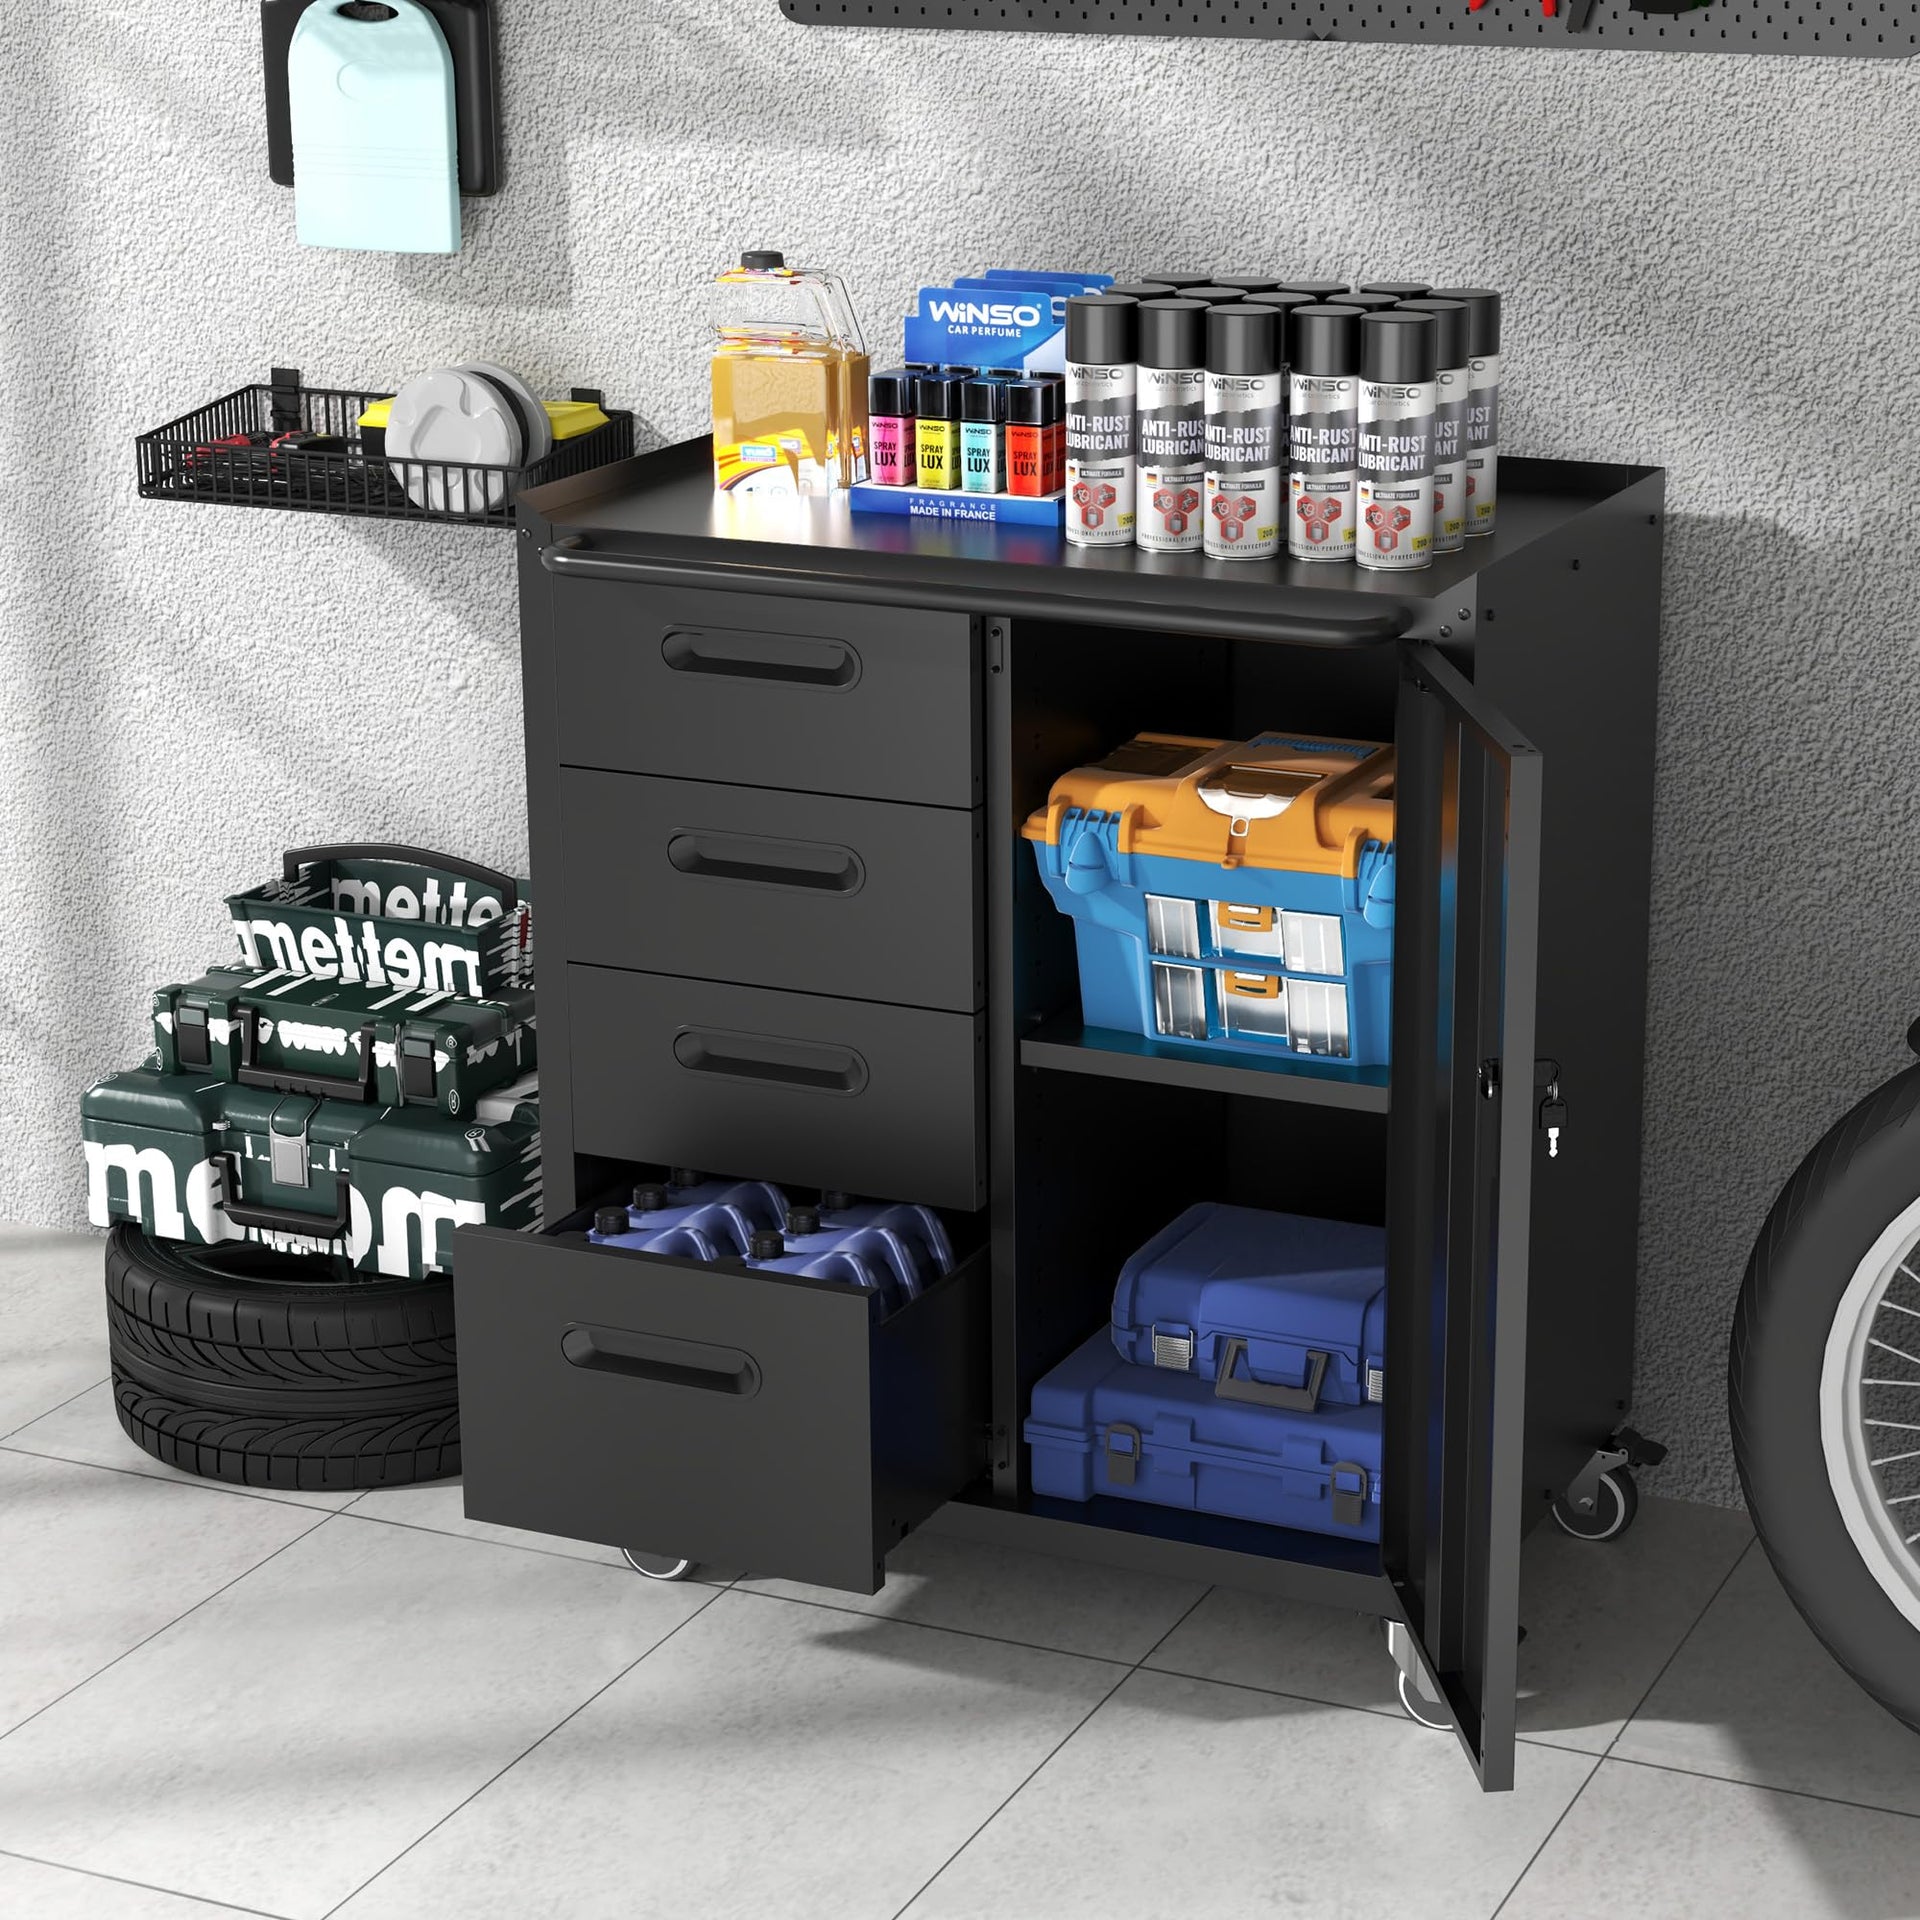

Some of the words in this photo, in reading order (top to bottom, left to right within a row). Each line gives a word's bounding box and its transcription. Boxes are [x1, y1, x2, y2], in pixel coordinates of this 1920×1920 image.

[947, 324, 969, 335] CAR
[971, 326, 1022, 338] PERFUME
[1142, 418, 1205, 438] ANTI-RUS
[1205, 423, 1272, 445] ANTI-RUST
[1290, 425, 1357, 446] ANTI-RUST
[874, 441, 897, 451] SPRAY
[921, 444, 944, 453] SPRAY
[1066, 431, 1130, 450] LUBRICANT
[1142, 438, 1205, 456] LUBRICAN
[1359, 432, 1427, 453] ANTI-RUST
[875, 451, 897, 467] LUX
[967, 447, 990, 457] SPRAY
[1014, 451, 1037, 460] SPRAY
[1205, 442, 1271, 463] LUBRICANT
[1290, 443, 1356, 464] LUBRICANT
[921, 454, 944, 470] LUX
[967, 457, 990, 473] LUX
[1014, 460, 1037, 476] LUX
[1358, 451, 1426, 471] LUBRICANT
[909, 498, 996, 511] FRAGRANCE
[910, 505, 939, 517] MADE
[941, 508, 952, 517] IN
[954, 509, 996, 521] FRANCE
